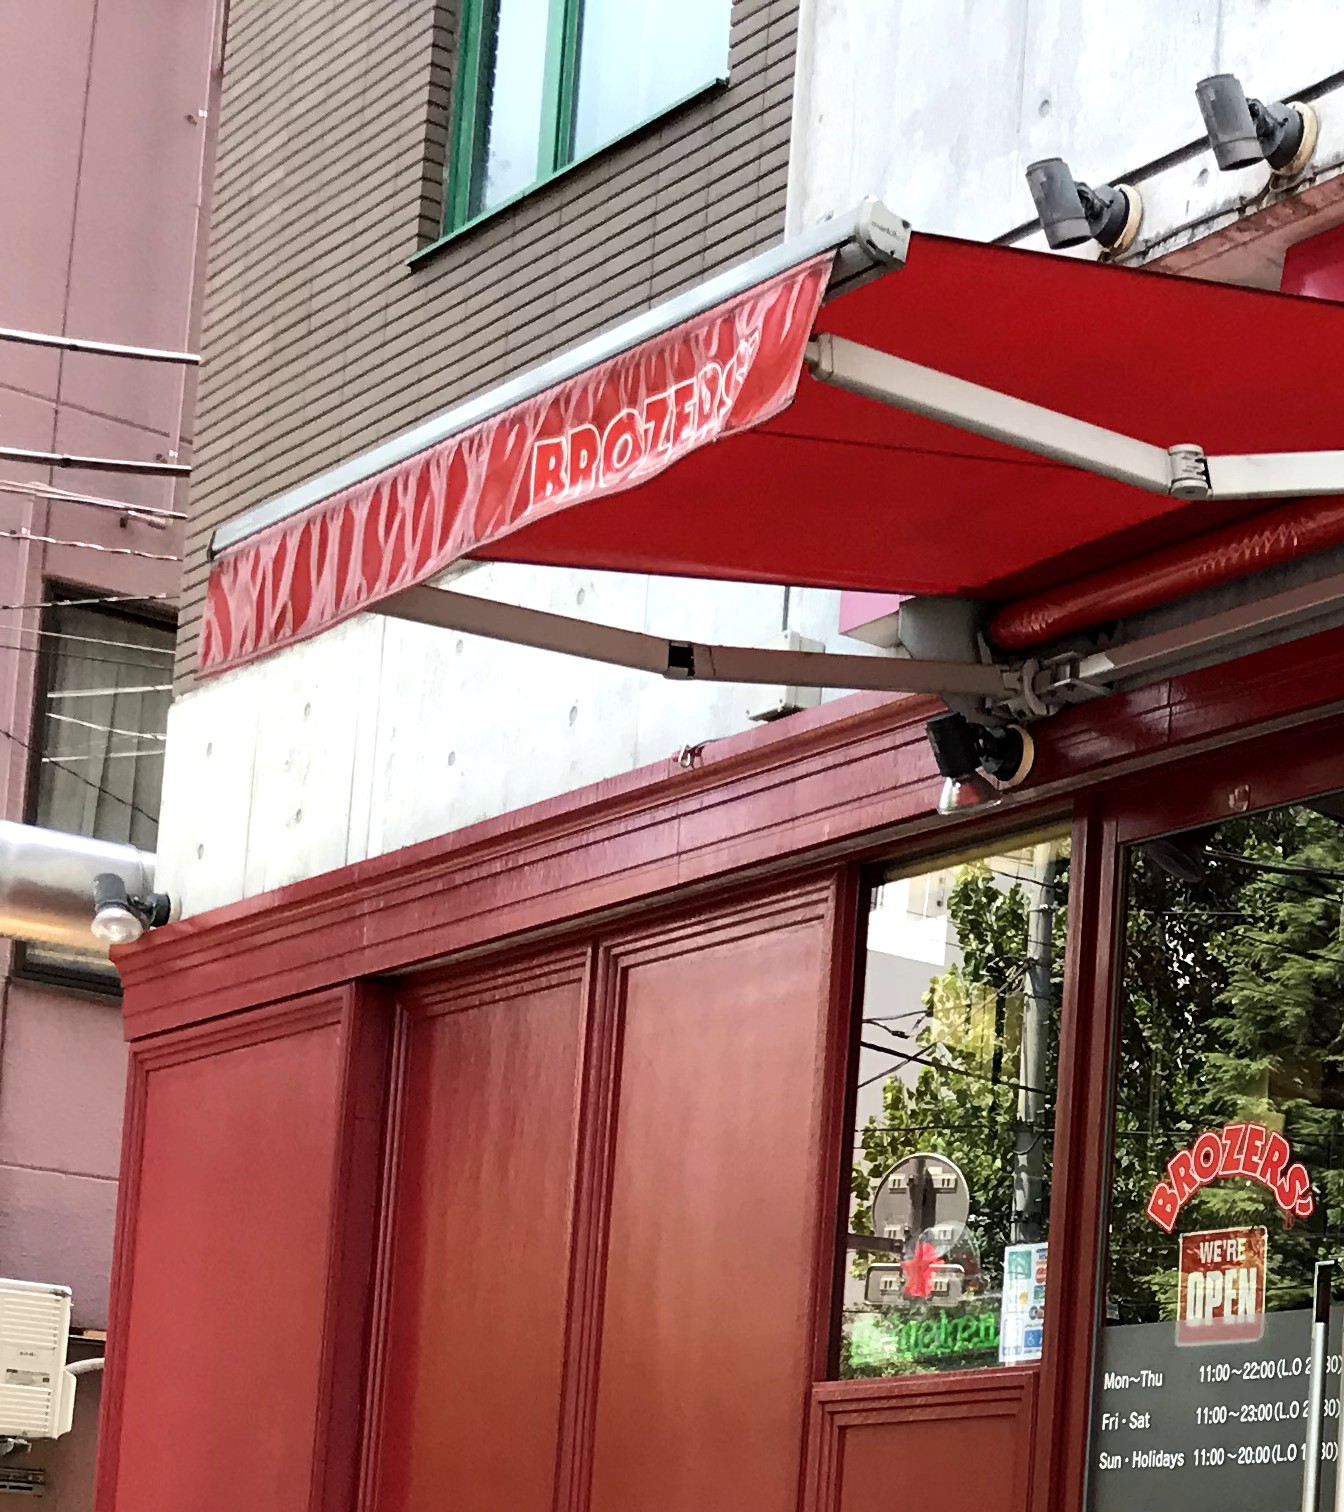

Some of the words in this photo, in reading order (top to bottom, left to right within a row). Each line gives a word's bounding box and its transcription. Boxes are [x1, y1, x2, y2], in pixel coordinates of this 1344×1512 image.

[1145, 1121, 1314, 1233] BROZERS'
[1200, 1238, 1247, 1264] WE'RE
[1186, 1267, 1258, 1328] OPEN
